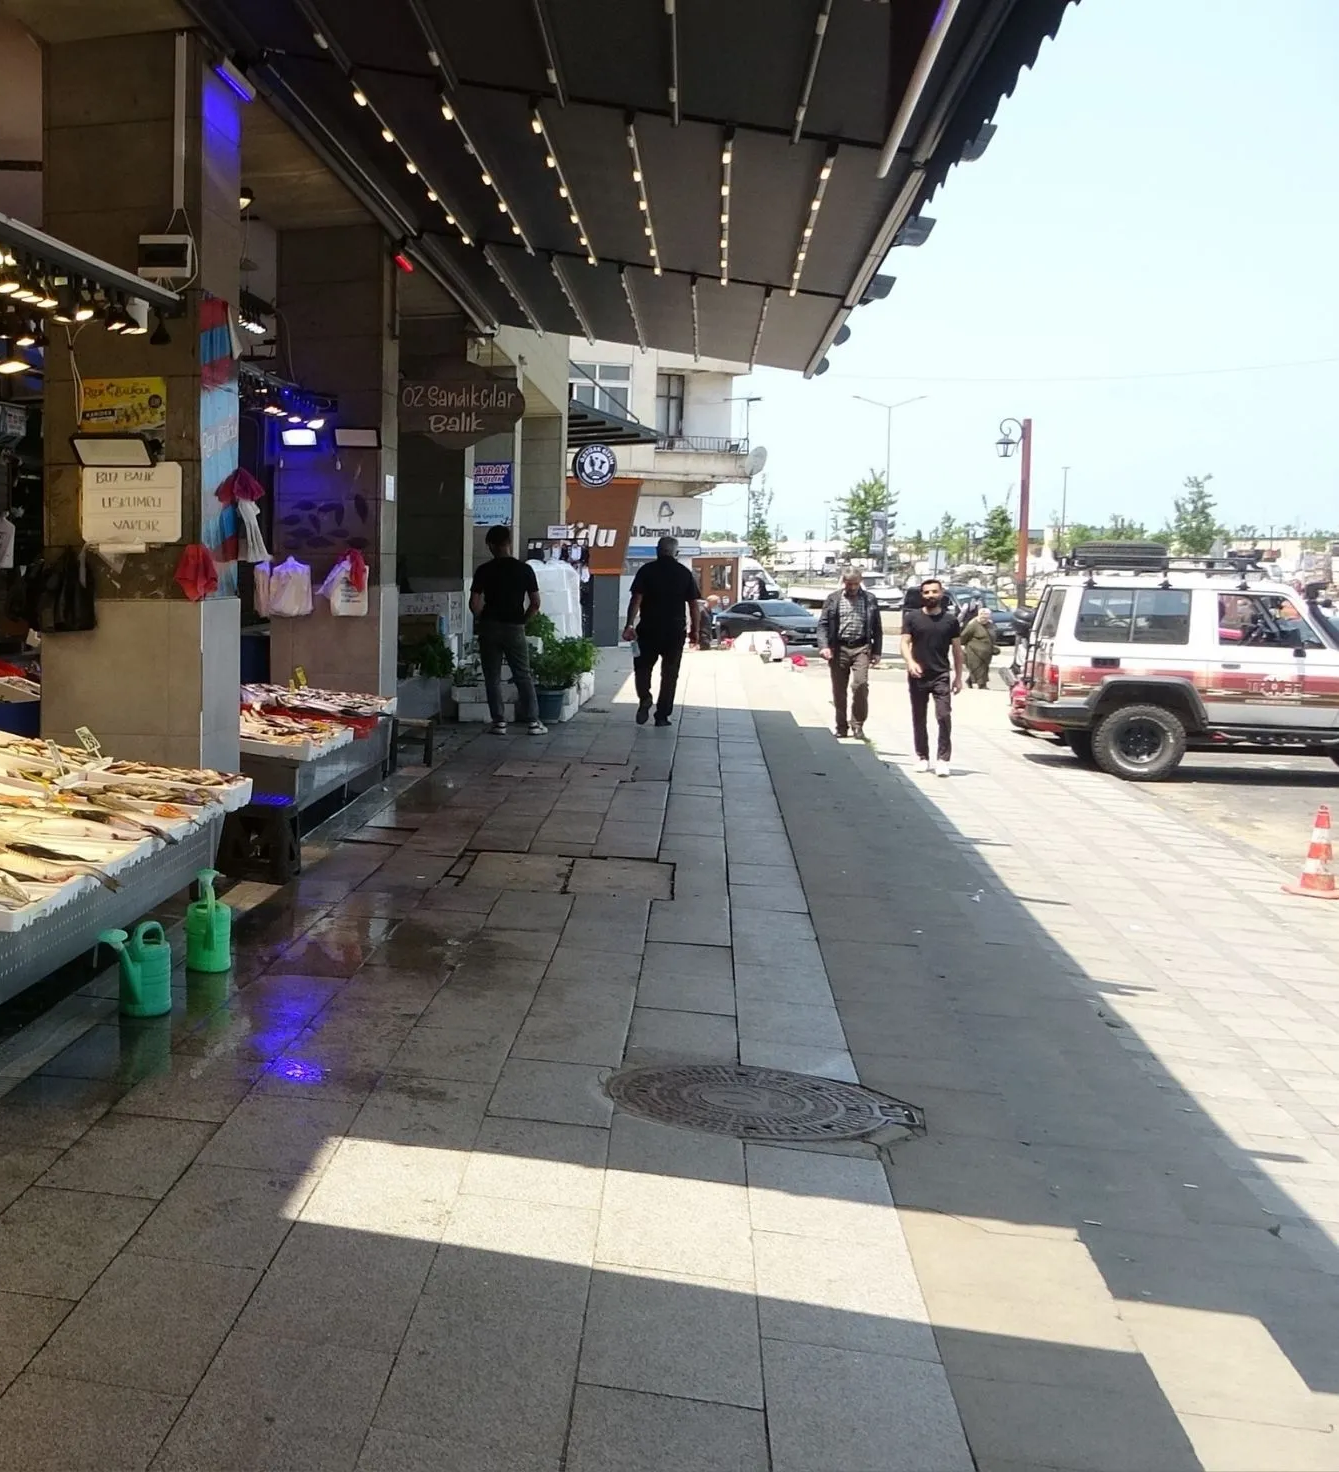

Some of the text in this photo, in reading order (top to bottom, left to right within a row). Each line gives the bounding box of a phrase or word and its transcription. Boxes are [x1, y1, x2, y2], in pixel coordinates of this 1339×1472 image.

[473, 464, 510, 475] AYRAK
[639, 525, 670, 537] Osman
[671, 526, 701, 541] Ulusoy
